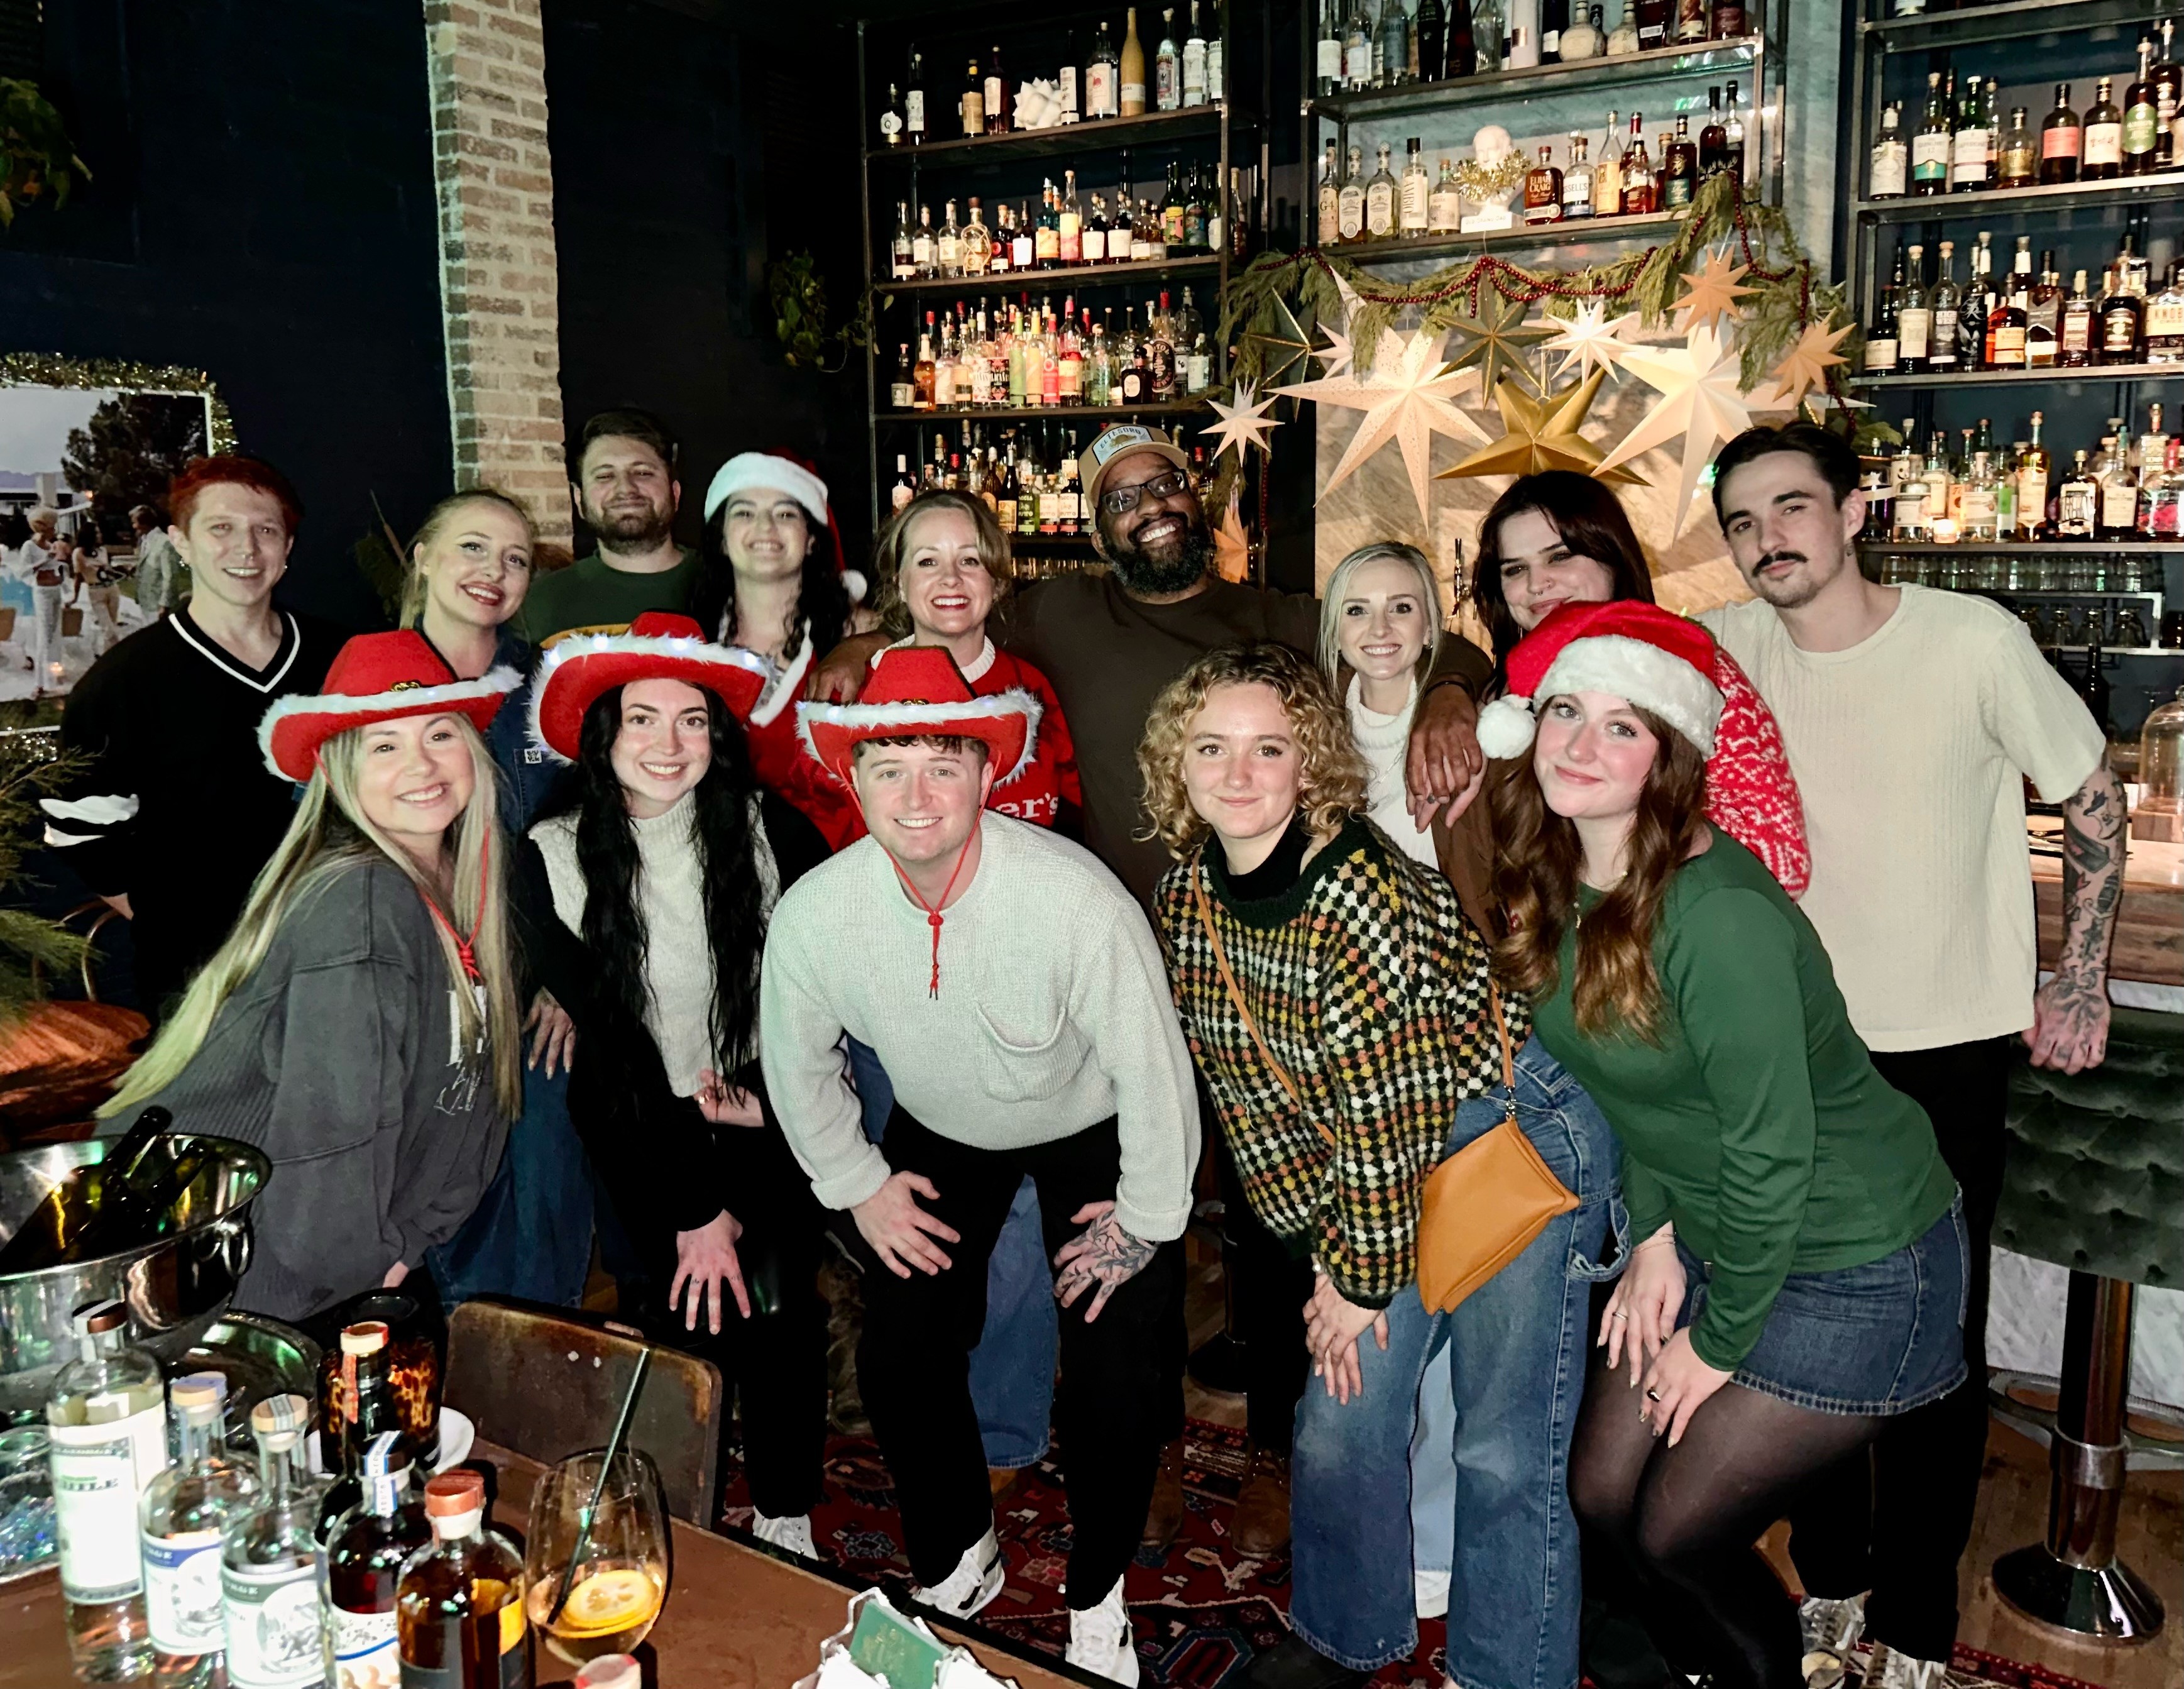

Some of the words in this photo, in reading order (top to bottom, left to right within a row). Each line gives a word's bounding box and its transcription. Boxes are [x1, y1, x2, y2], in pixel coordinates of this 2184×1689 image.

[1530, 175, 1551, 185] ELIJAH
[1529, 183, 1550, 193] CRAIG
[1100, 439, 1108, 449] EL
[1106, 427, 1141, 440] TESORO
